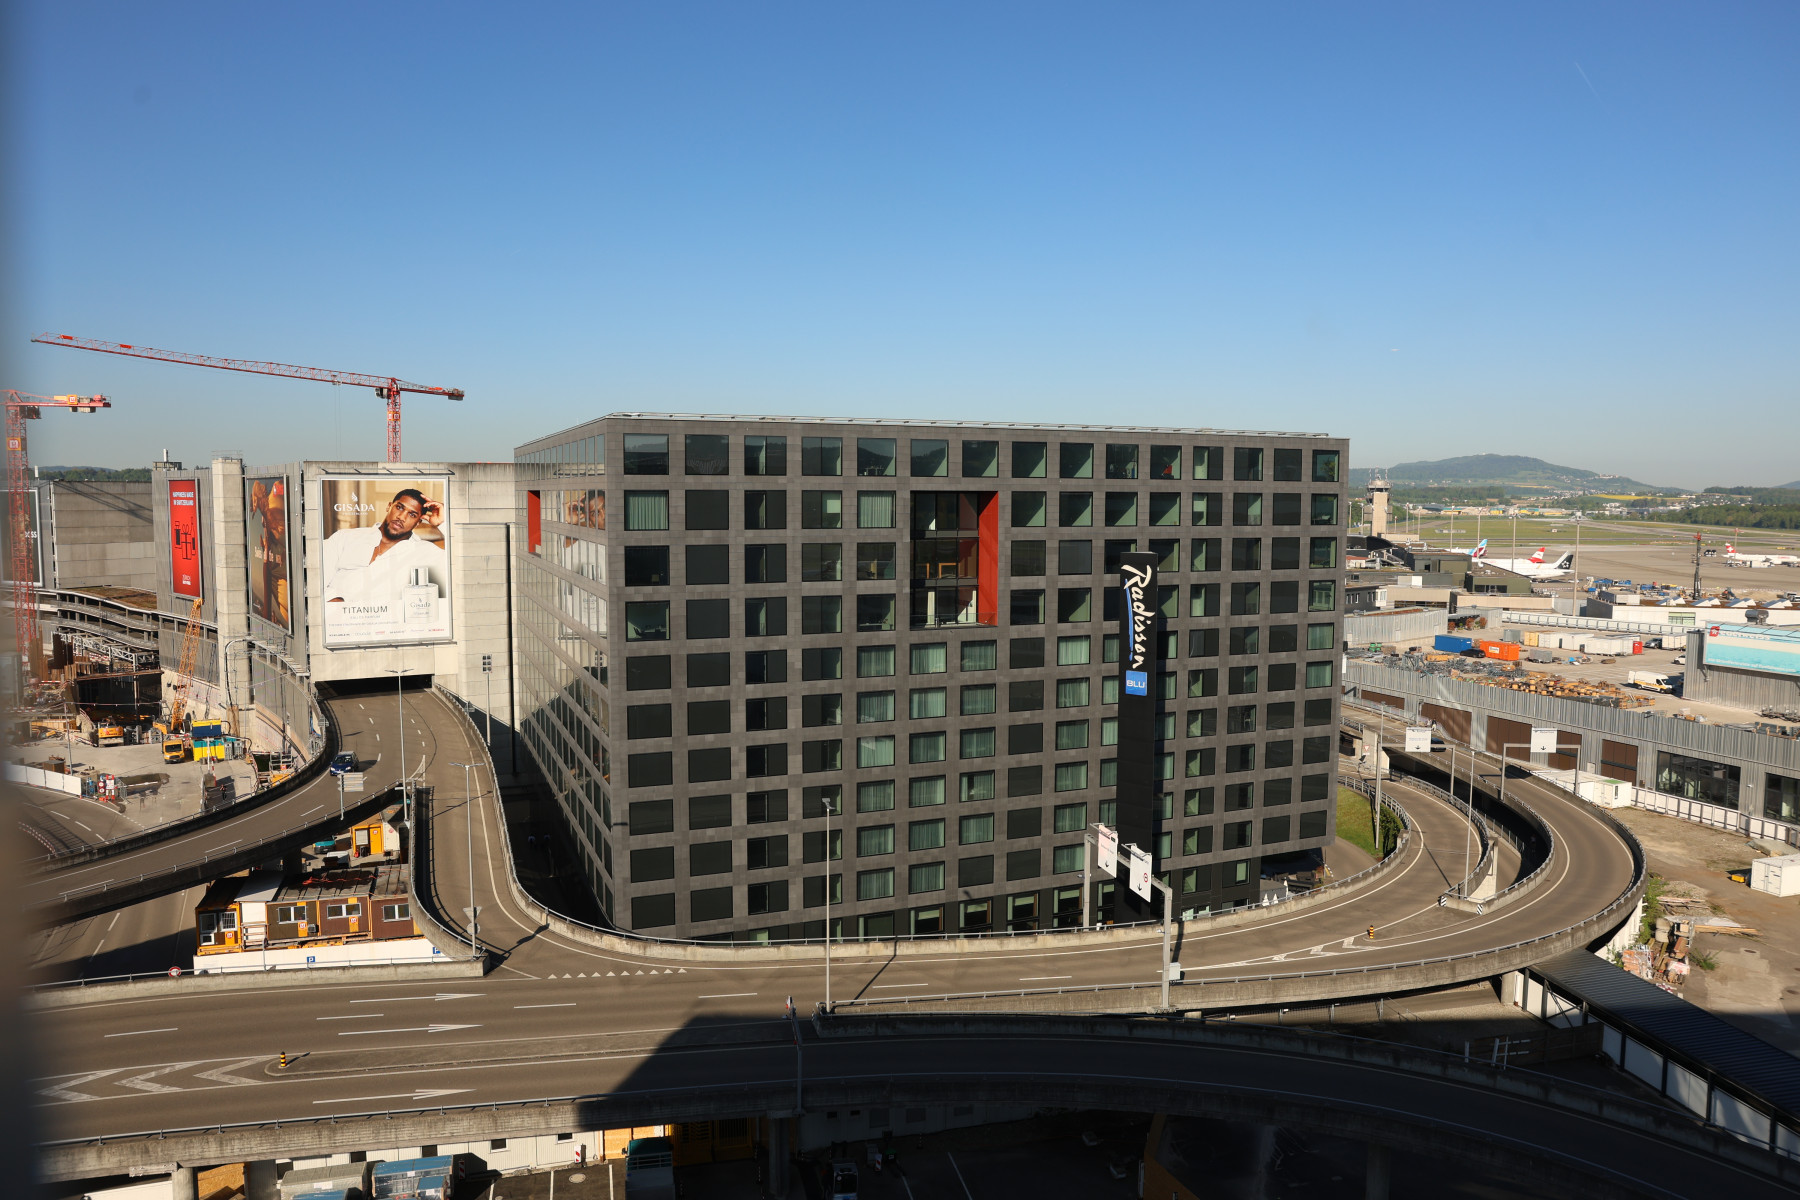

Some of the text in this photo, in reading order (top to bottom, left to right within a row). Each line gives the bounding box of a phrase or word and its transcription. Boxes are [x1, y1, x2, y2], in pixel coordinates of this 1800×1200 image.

[333, 503, 376, 512] GISADA
[342, 605, 388, 614] TITANIUM
[1121, 564, 1156, 669] Radisson
[1126, 679, 1146, 689] BLU
